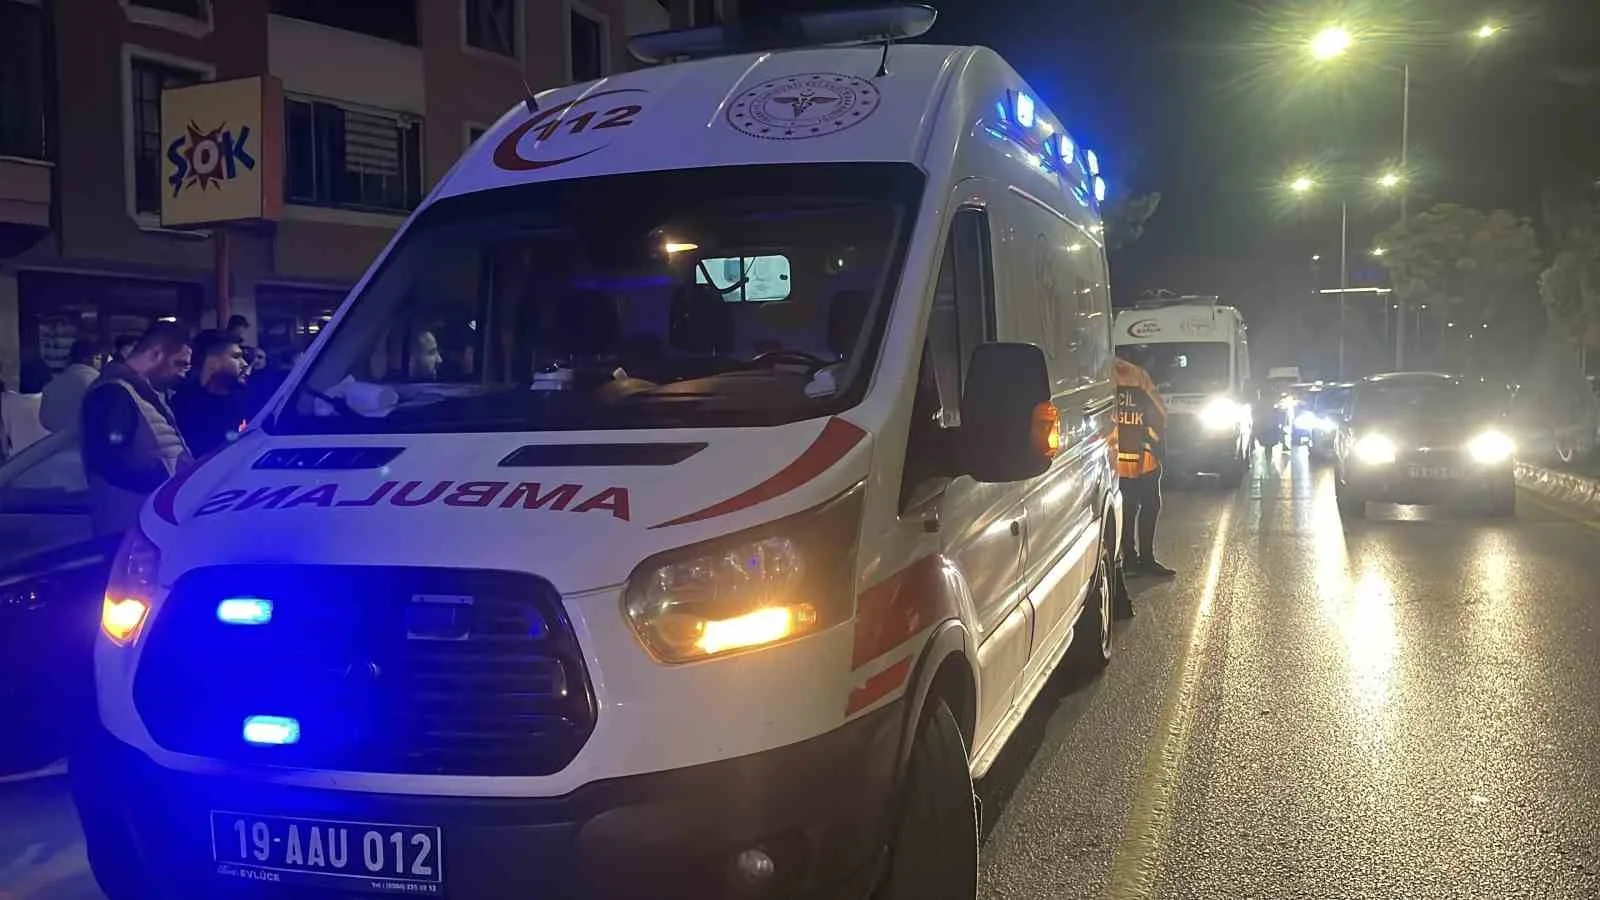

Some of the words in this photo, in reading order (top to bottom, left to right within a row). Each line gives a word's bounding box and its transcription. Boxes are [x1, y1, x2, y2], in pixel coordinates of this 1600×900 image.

[533, 105, 642, 141] 112
[167, 125, 255, 198] ŞOK
[233, 819, 348, 867] 19-AAU
[363, 830, 433, 876] 012
